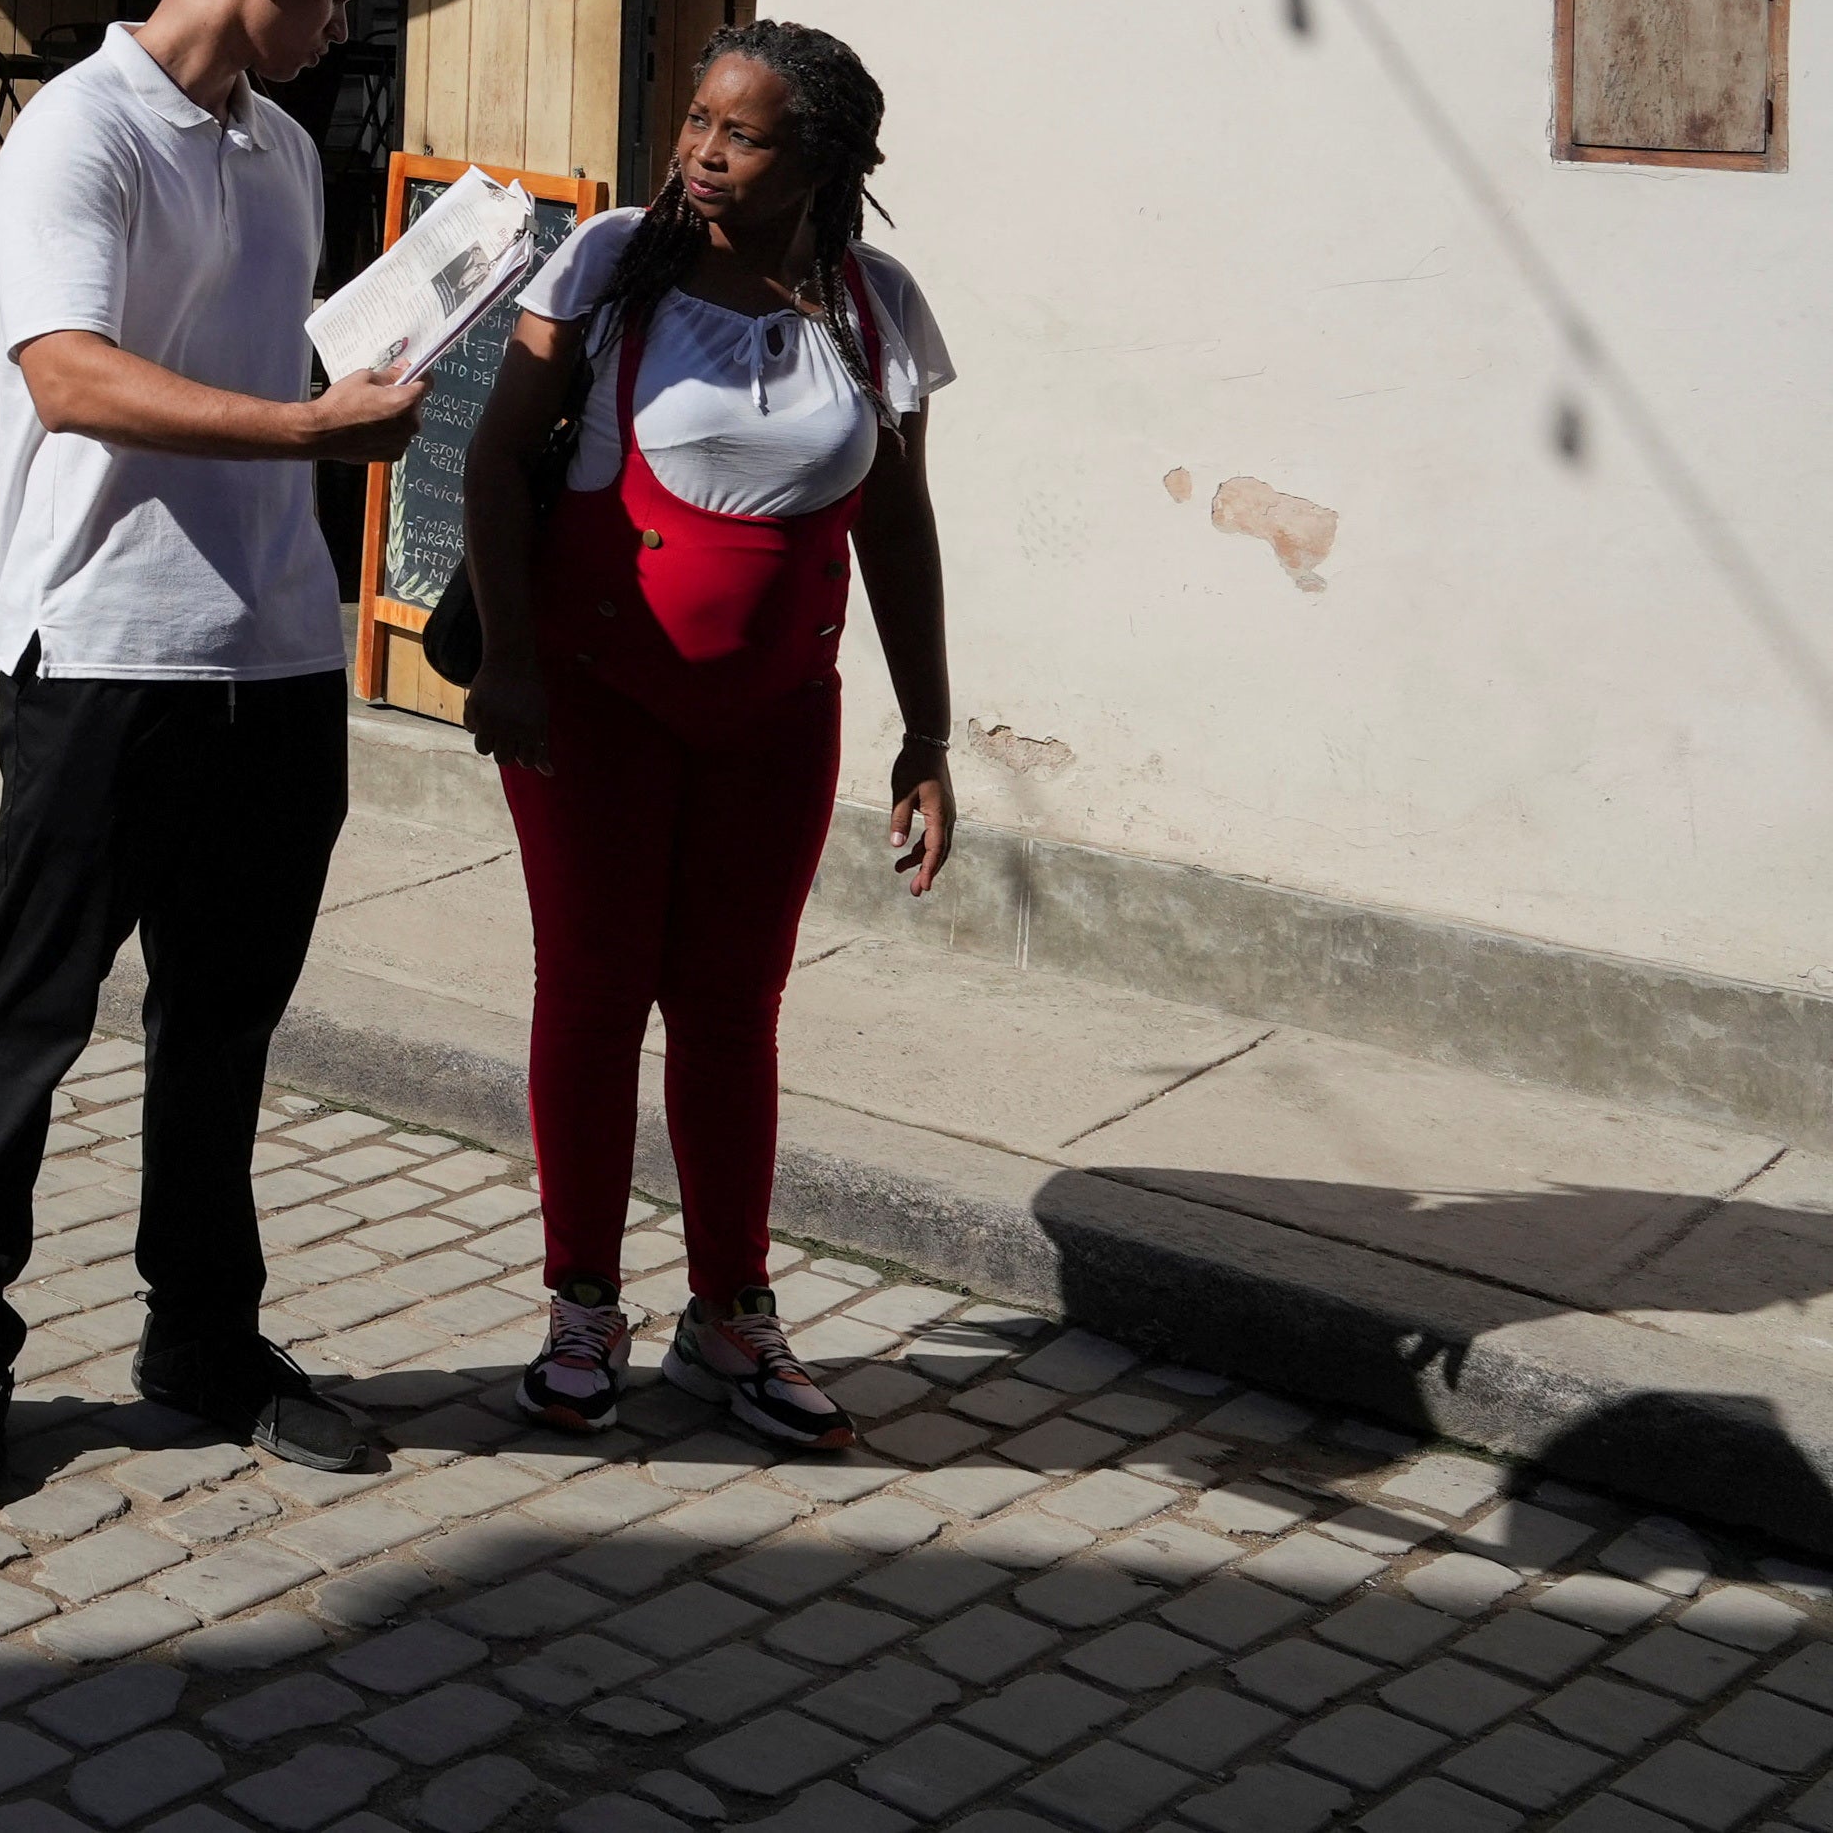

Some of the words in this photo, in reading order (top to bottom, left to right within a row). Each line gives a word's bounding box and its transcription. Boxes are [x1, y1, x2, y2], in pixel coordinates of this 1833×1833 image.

[433, 357, 467, 378] AITO
[421, 406, 474, 430] RRANO
[416, 435, 466, 464] TOSTON
[415, 478, 464, 504] CEVICH
[406, 528, 465, 555] MARGAR
[412, 547, 461, 568] FRITU
